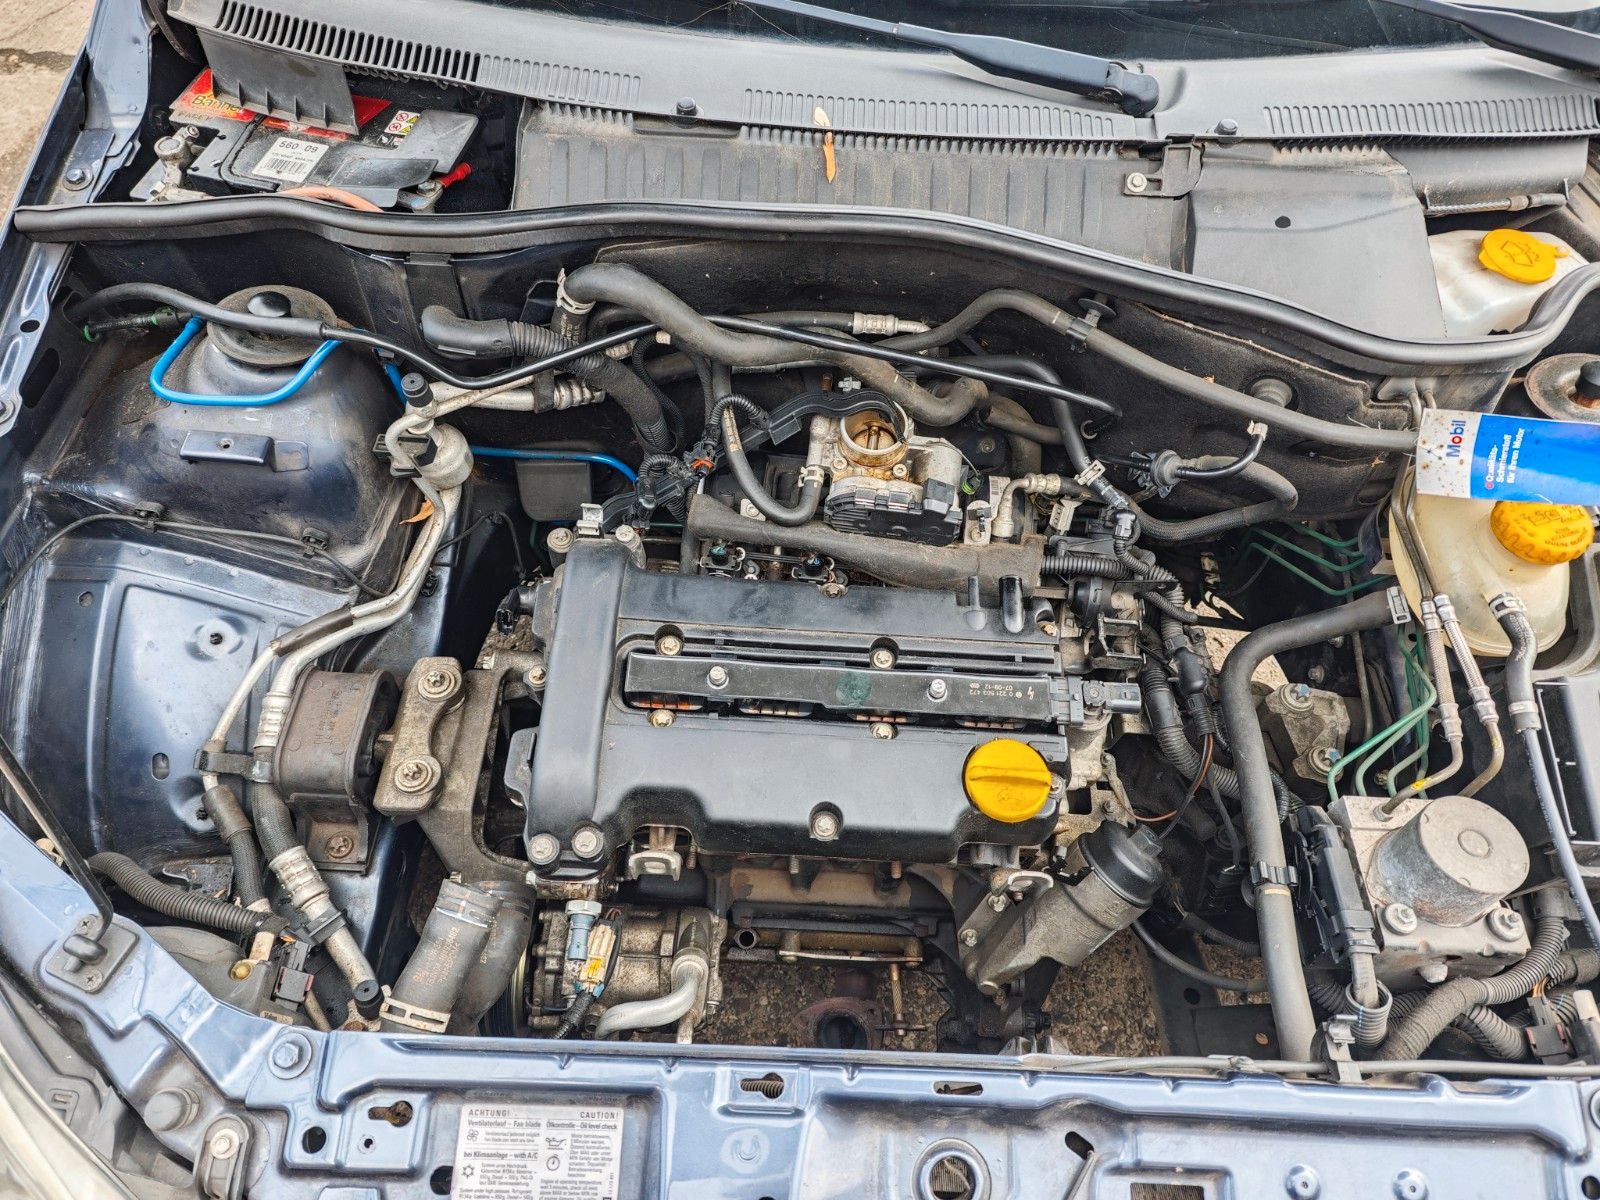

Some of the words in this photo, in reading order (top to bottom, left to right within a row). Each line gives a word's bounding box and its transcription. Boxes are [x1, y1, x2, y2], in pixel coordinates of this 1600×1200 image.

[279, 141, 299, 150] 560
[304, 145, 319, 153] 09
[1446, 420, 1466, 457] Mobil
[1512, 427, 1525, 449] Motor
[468, 1109, 511, 1117] ACHTUNG!
[580, 1111, 619, 1120] CAUTION!
